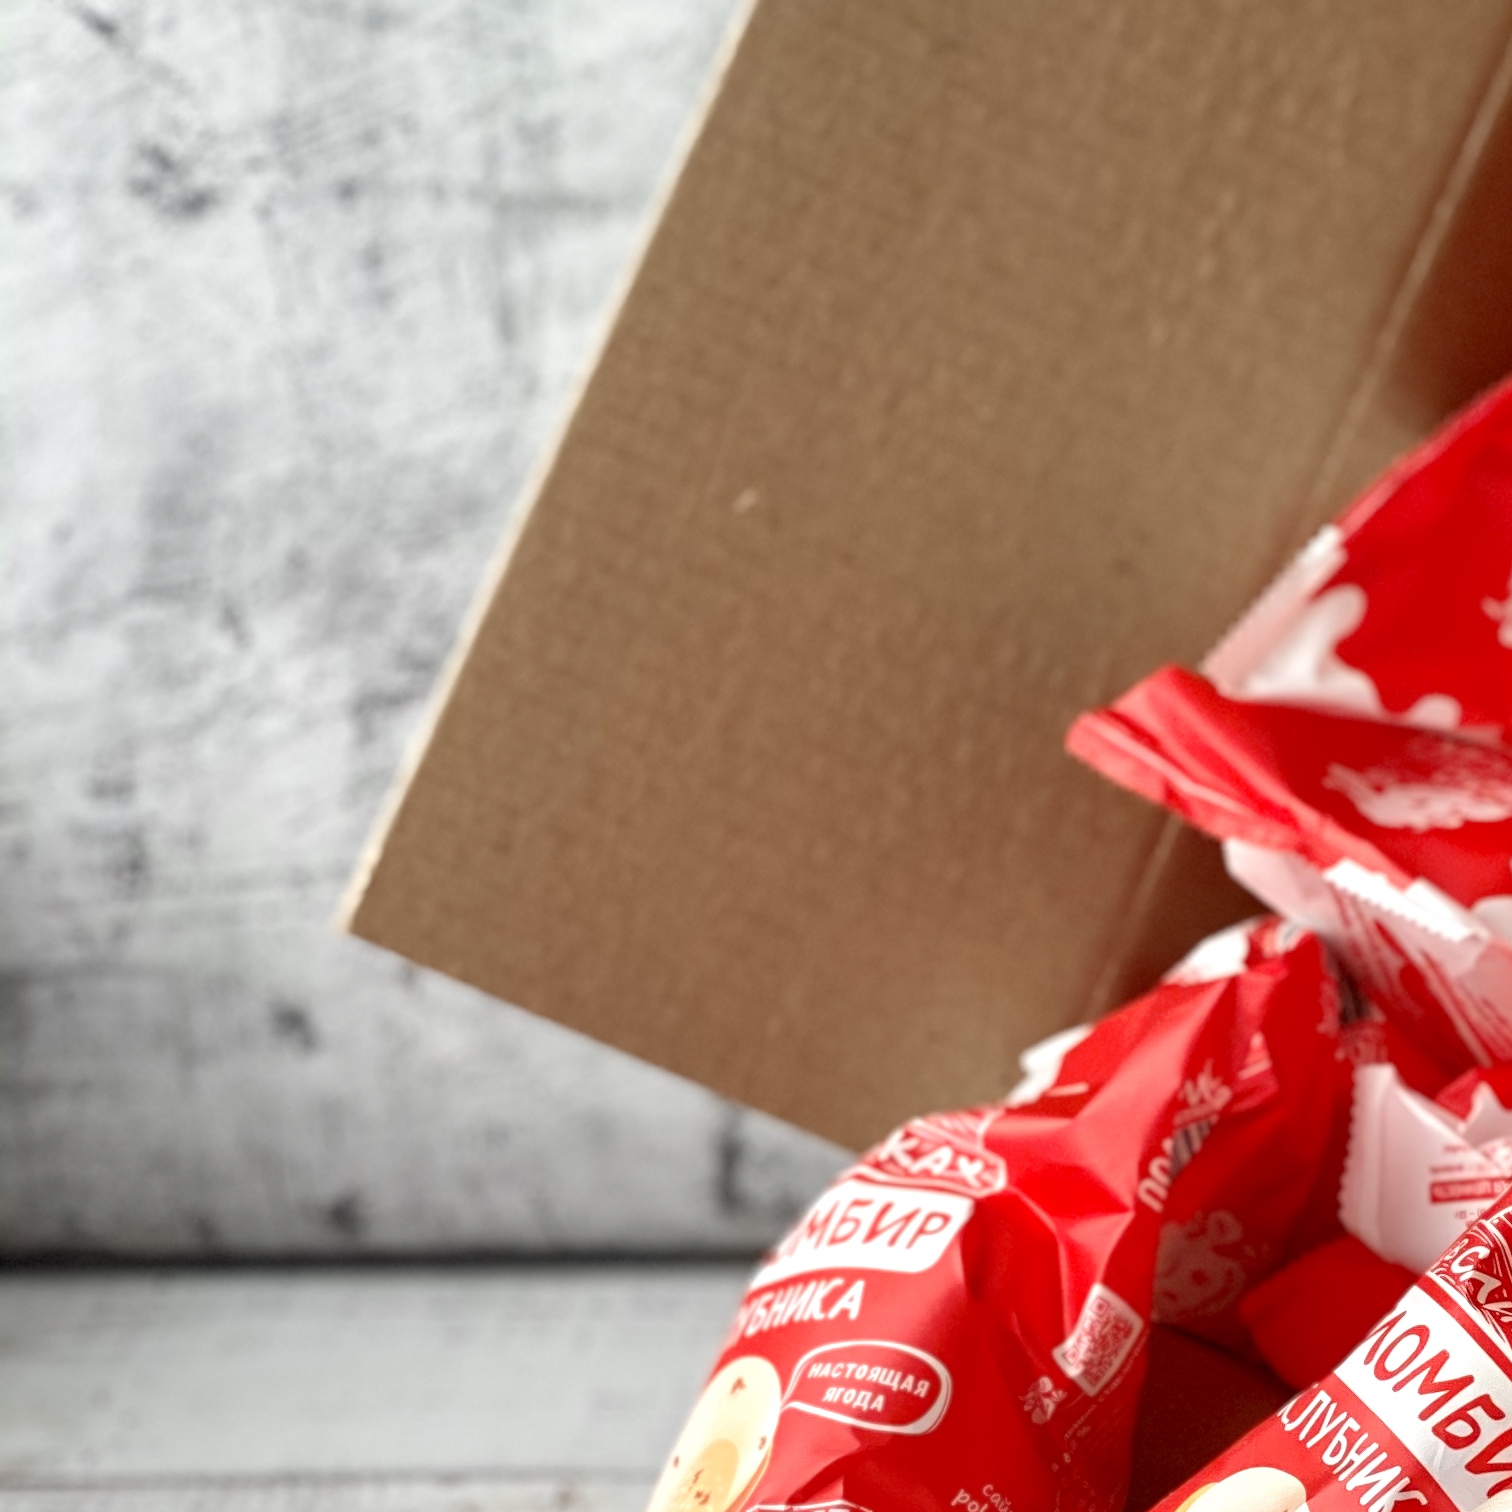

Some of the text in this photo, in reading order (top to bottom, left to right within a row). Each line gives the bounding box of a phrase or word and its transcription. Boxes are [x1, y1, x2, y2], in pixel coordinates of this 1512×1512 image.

[736, 1280, 866, 1338] УБНИКА
[808, 1362, 930, 1399] НАСТОЯЩАЯ
[821, 1385, 886, 1412] ЯГОДА
